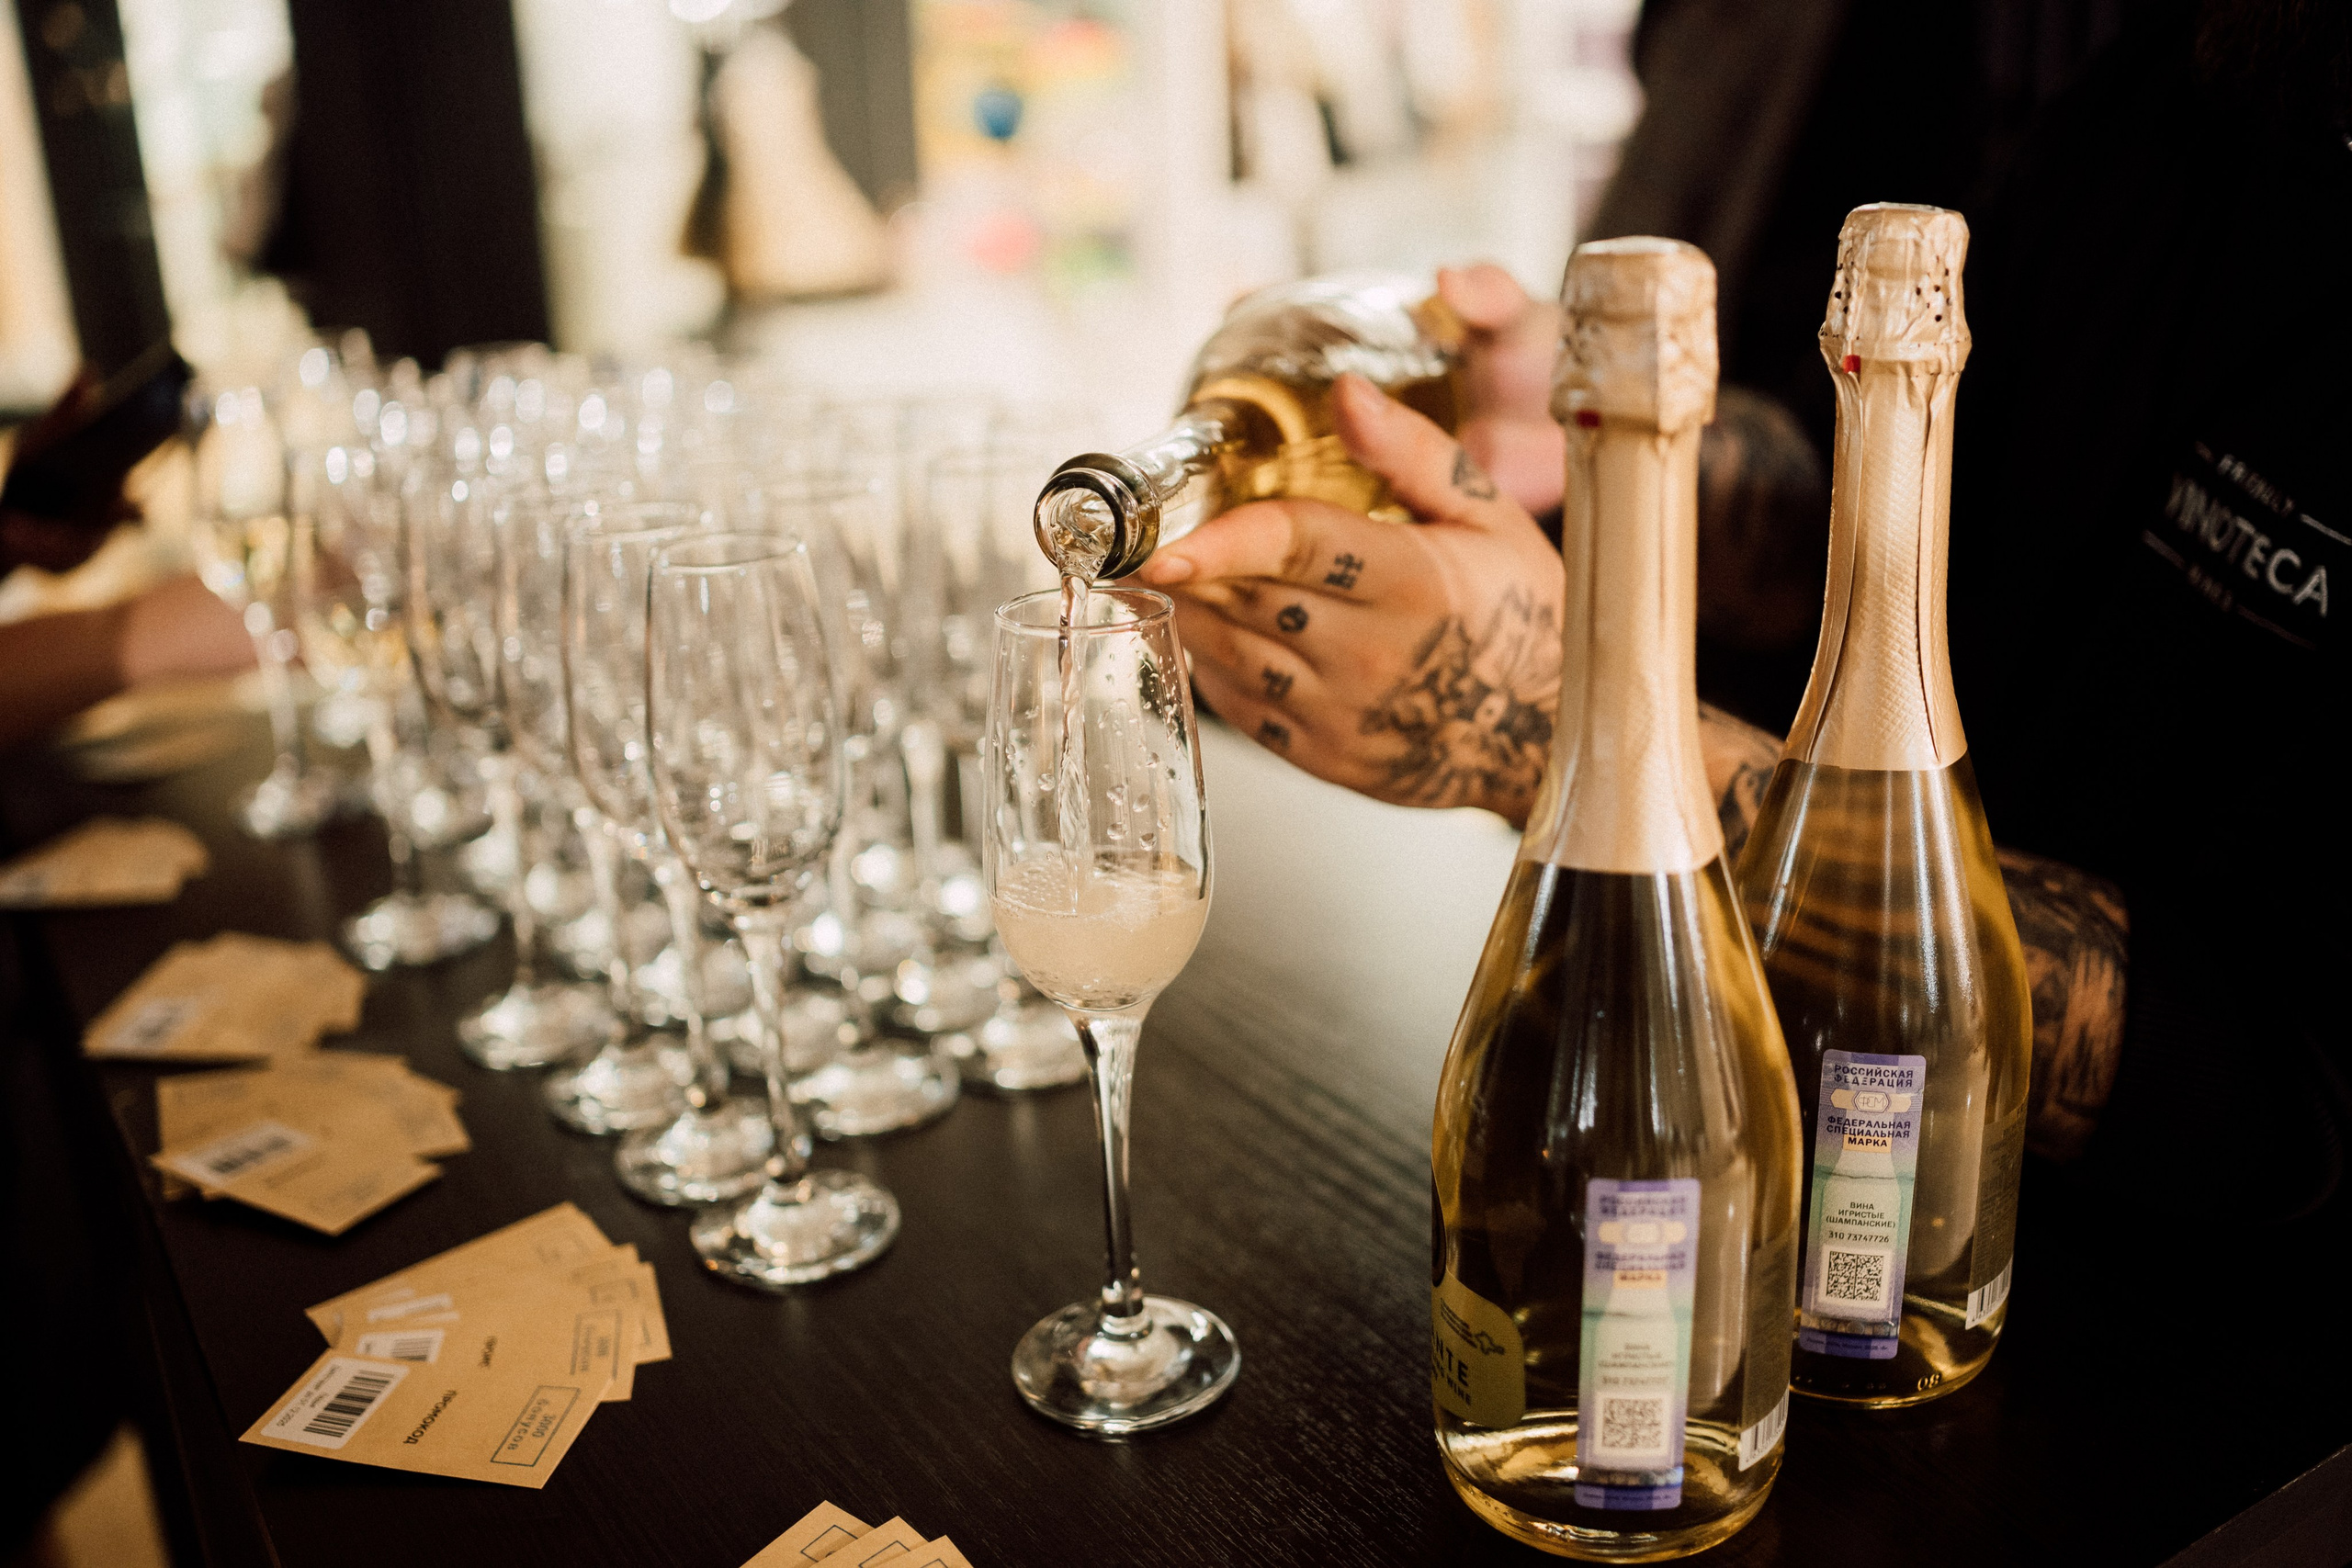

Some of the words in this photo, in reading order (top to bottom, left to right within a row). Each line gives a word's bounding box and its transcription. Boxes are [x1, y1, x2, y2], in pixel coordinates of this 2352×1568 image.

[1834, 1065, 1914, 1078] РОССИЙСКАЯ
[1834, 1074, 1913, 1088] ФЕДЕРАЦИЯ
[1827, 1116, 1911, 1129] ФЕДЕРАЛЬНАЯ
[1826, 1125, 1910, 1138] СПЕЦИАЛЬНАЯ
[1848, 1137, 1888, 1146] МАРКА
[1850, 1201, 1874, 1210] ВИНА
[1838, 1209, 1884, 1219] ИГРИСТЫЕ
[1826, 1215, 1896, 1228] (ШАМПАНСКИЕ)
[1432, 1324, 1468, 1387] NTE
[403, 1390, 458, 1445] ПРОМОКОД
